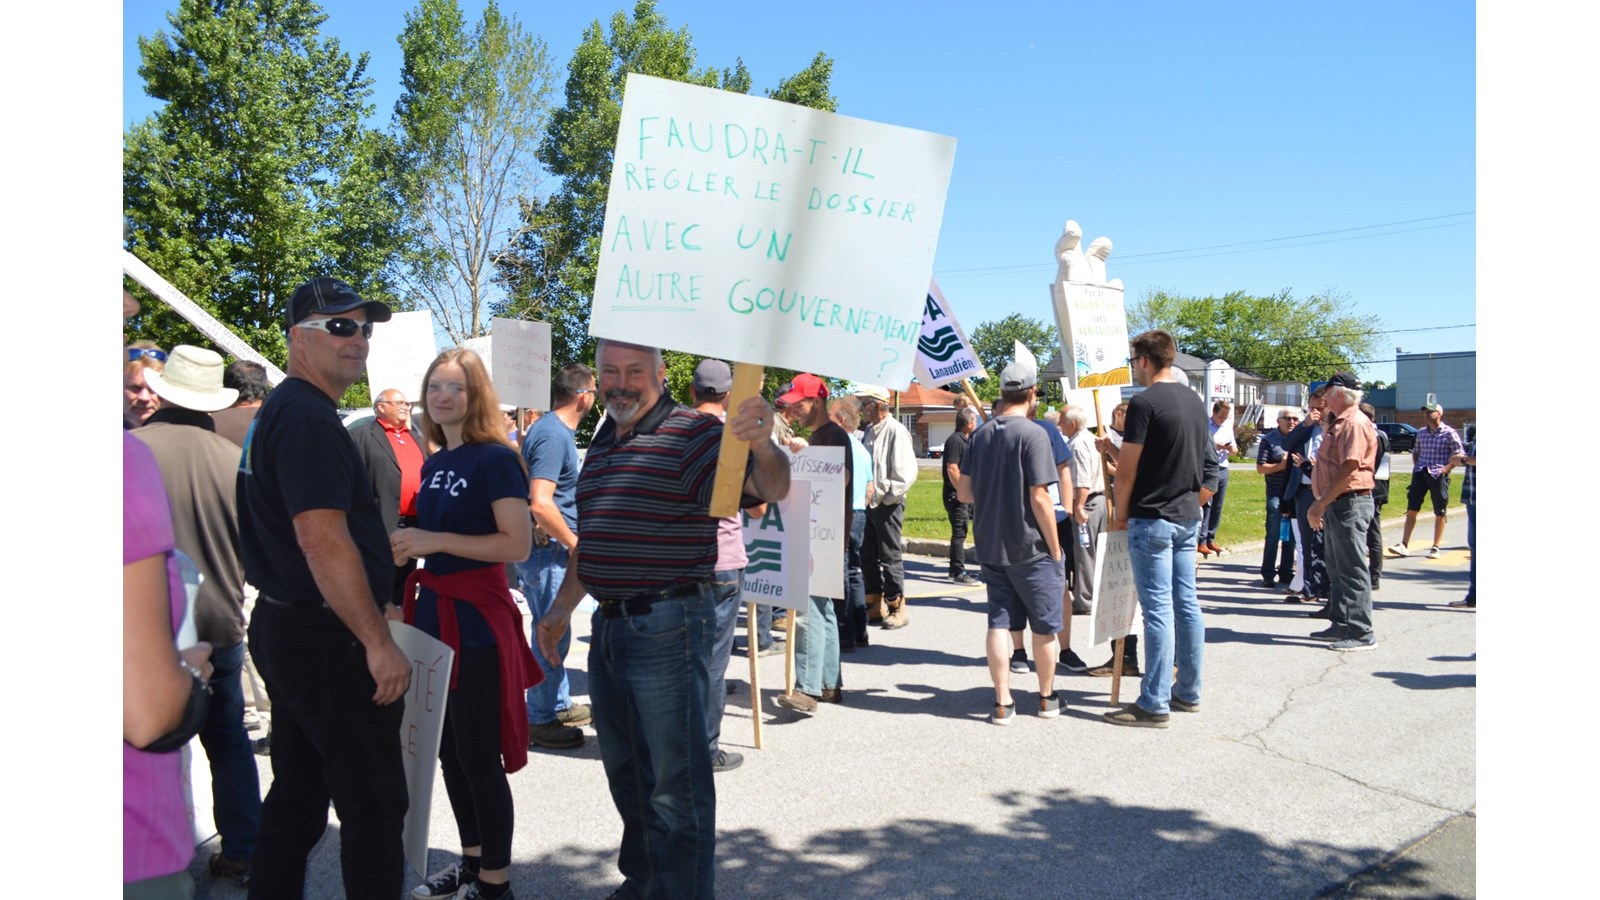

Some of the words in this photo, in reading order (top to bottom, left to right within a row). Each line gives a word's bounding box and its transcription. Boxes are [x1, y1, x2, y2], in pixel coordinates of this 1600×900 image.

[638, 116, 876, 179] FAUDRA-T-IL
[624, 162, 740, 199] REGLER
[754, 180, 782, 202] LE
[808, 187, 916, 223] DOSSIER
[611, 215, 703, 253] AVEC
[737, 223, 792, 262] UN
[616, 264, 704, 304] AUTRE
[727, 278, 921, 346] GOUVERNEMENT
[790, 454, 845, 475] RTISSEMENT
[743, 578, 784, 597] udière
